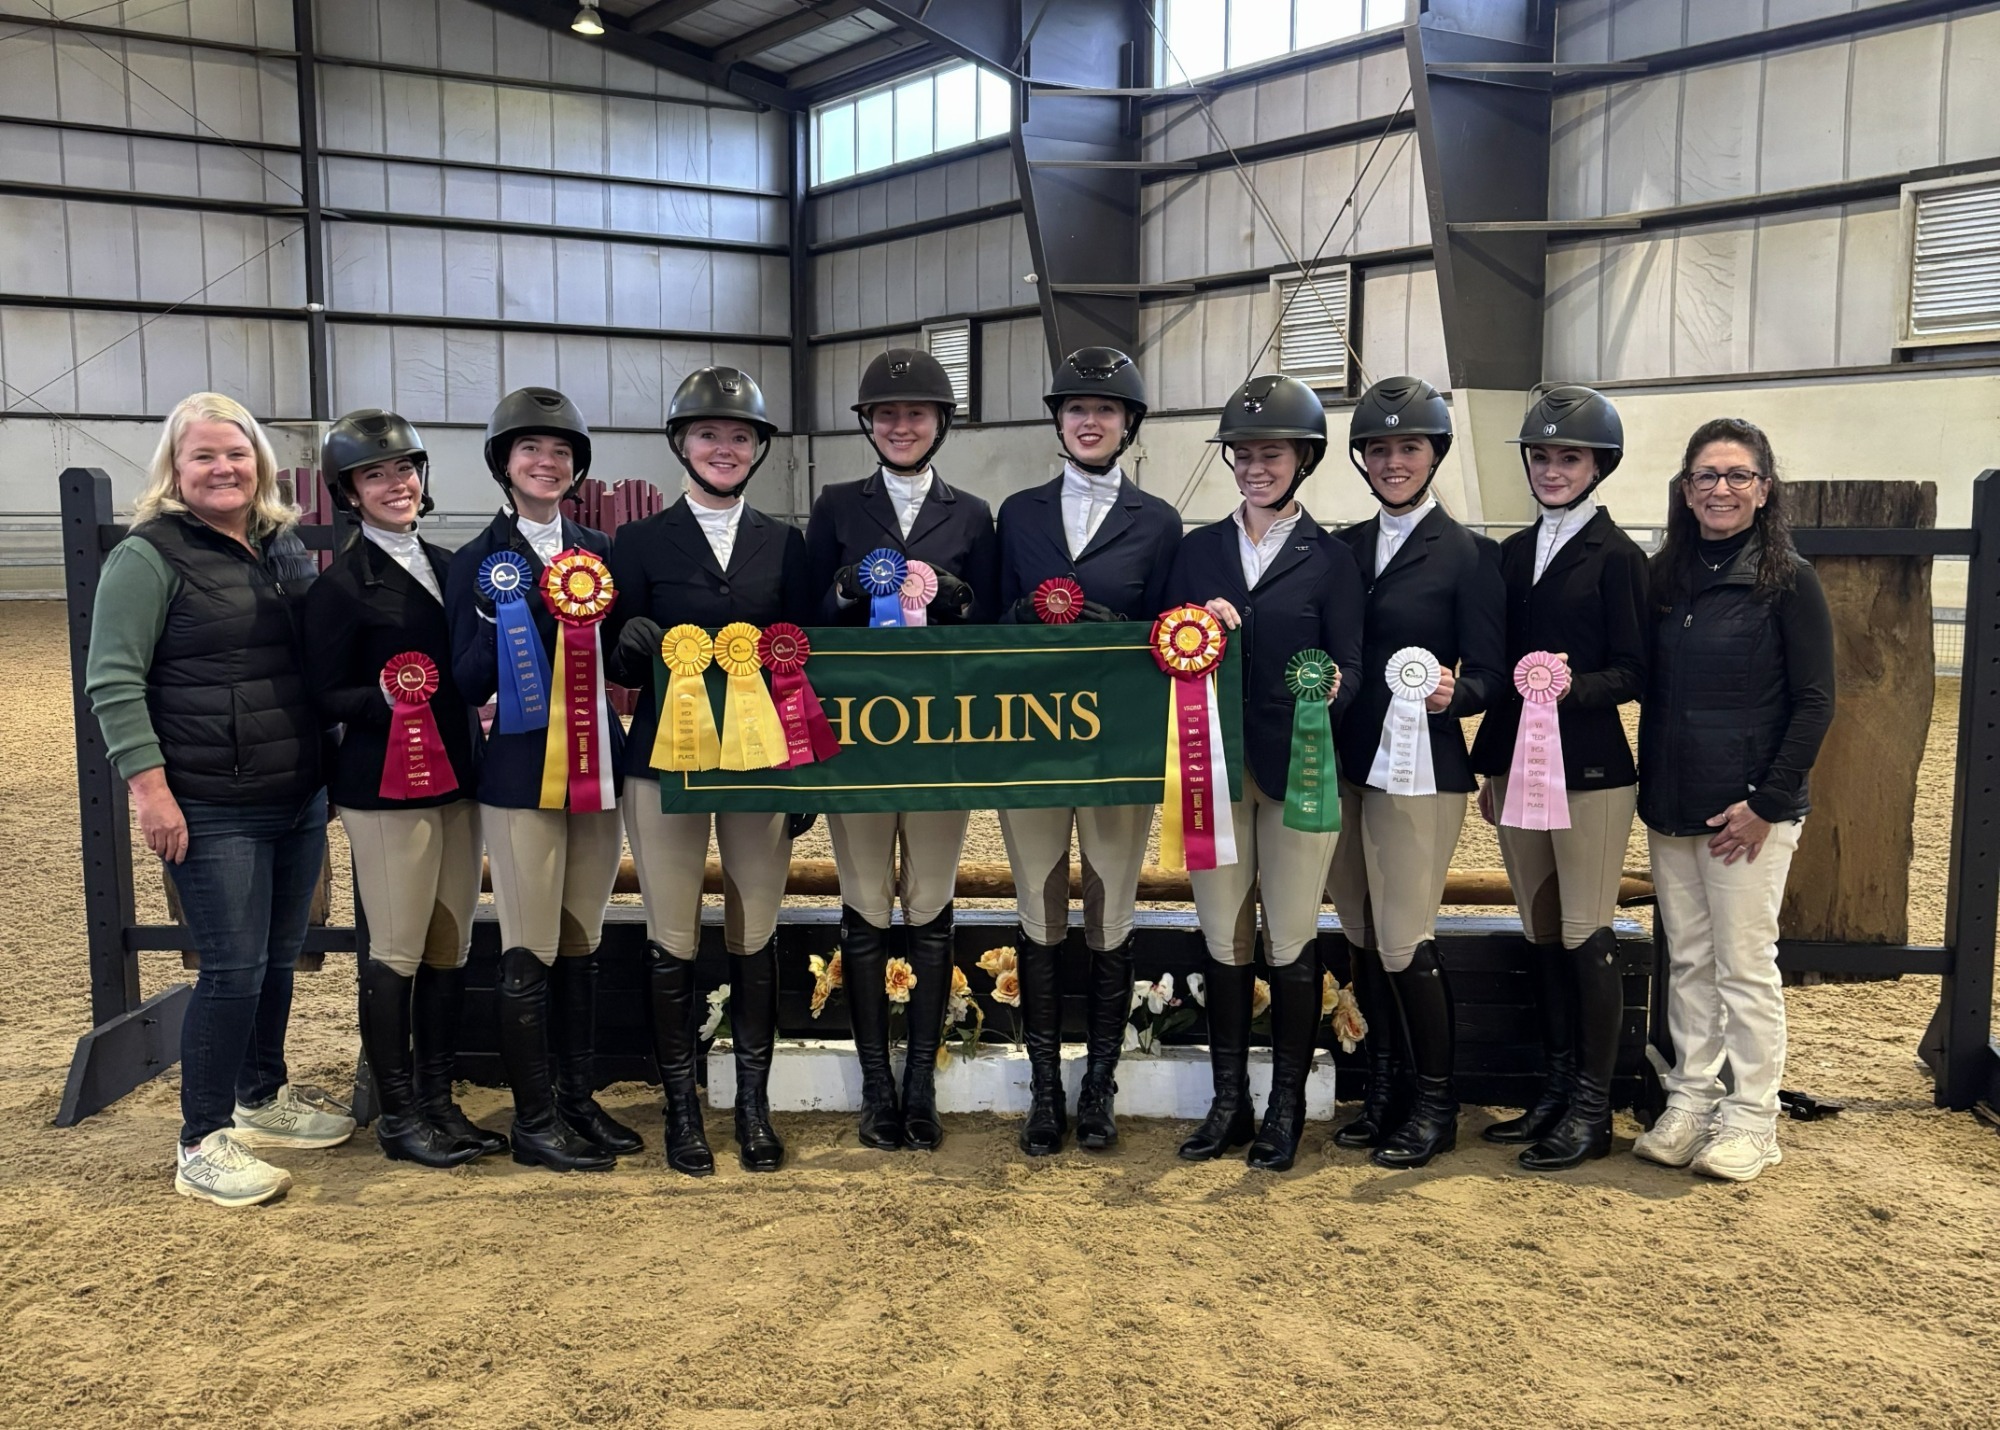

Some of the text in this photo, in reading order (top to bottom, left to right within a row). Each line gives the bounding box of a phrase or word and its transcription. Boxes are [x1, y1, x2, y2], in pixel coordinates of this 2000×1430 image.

[525, 704, 542, 713] PLACE
[579, 754, 589, 774] POINT
[407, 771, 430, 779] SECOND
